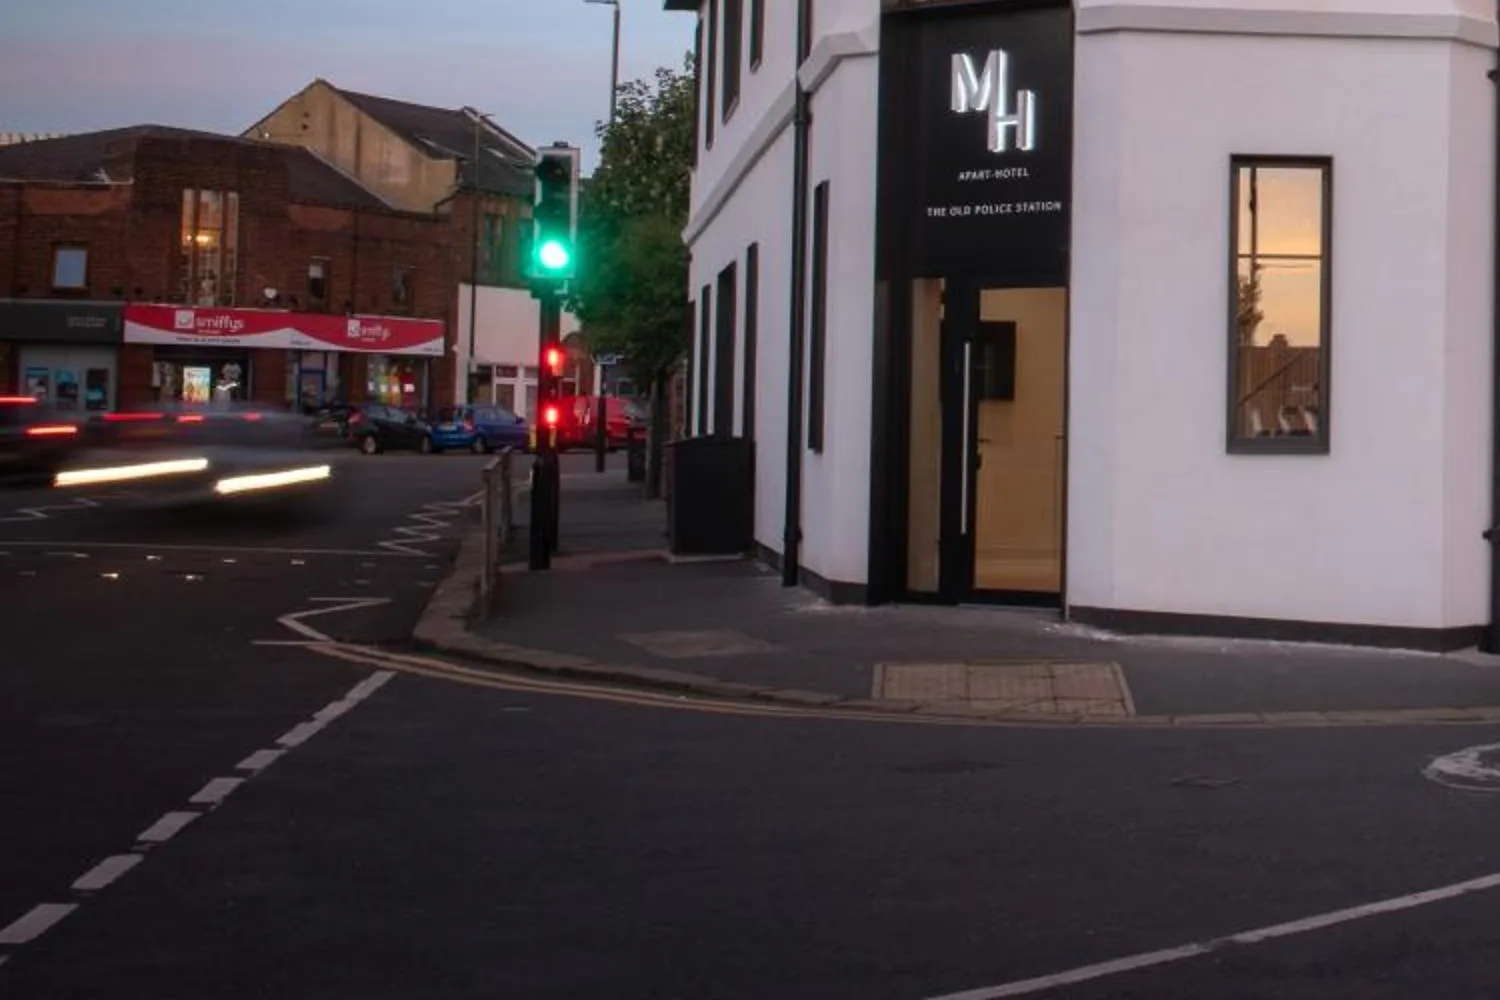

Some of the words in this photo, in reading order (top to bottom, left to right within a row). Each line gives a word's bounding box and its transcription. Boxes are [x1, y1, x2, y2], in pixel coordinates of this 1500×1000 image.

[927, 206, 946, 217] THE
[949, 205, 971, 216] OLD
[974, 203, 1013, 215] POLICE
[1014, 201, 1062, 214] STATION
